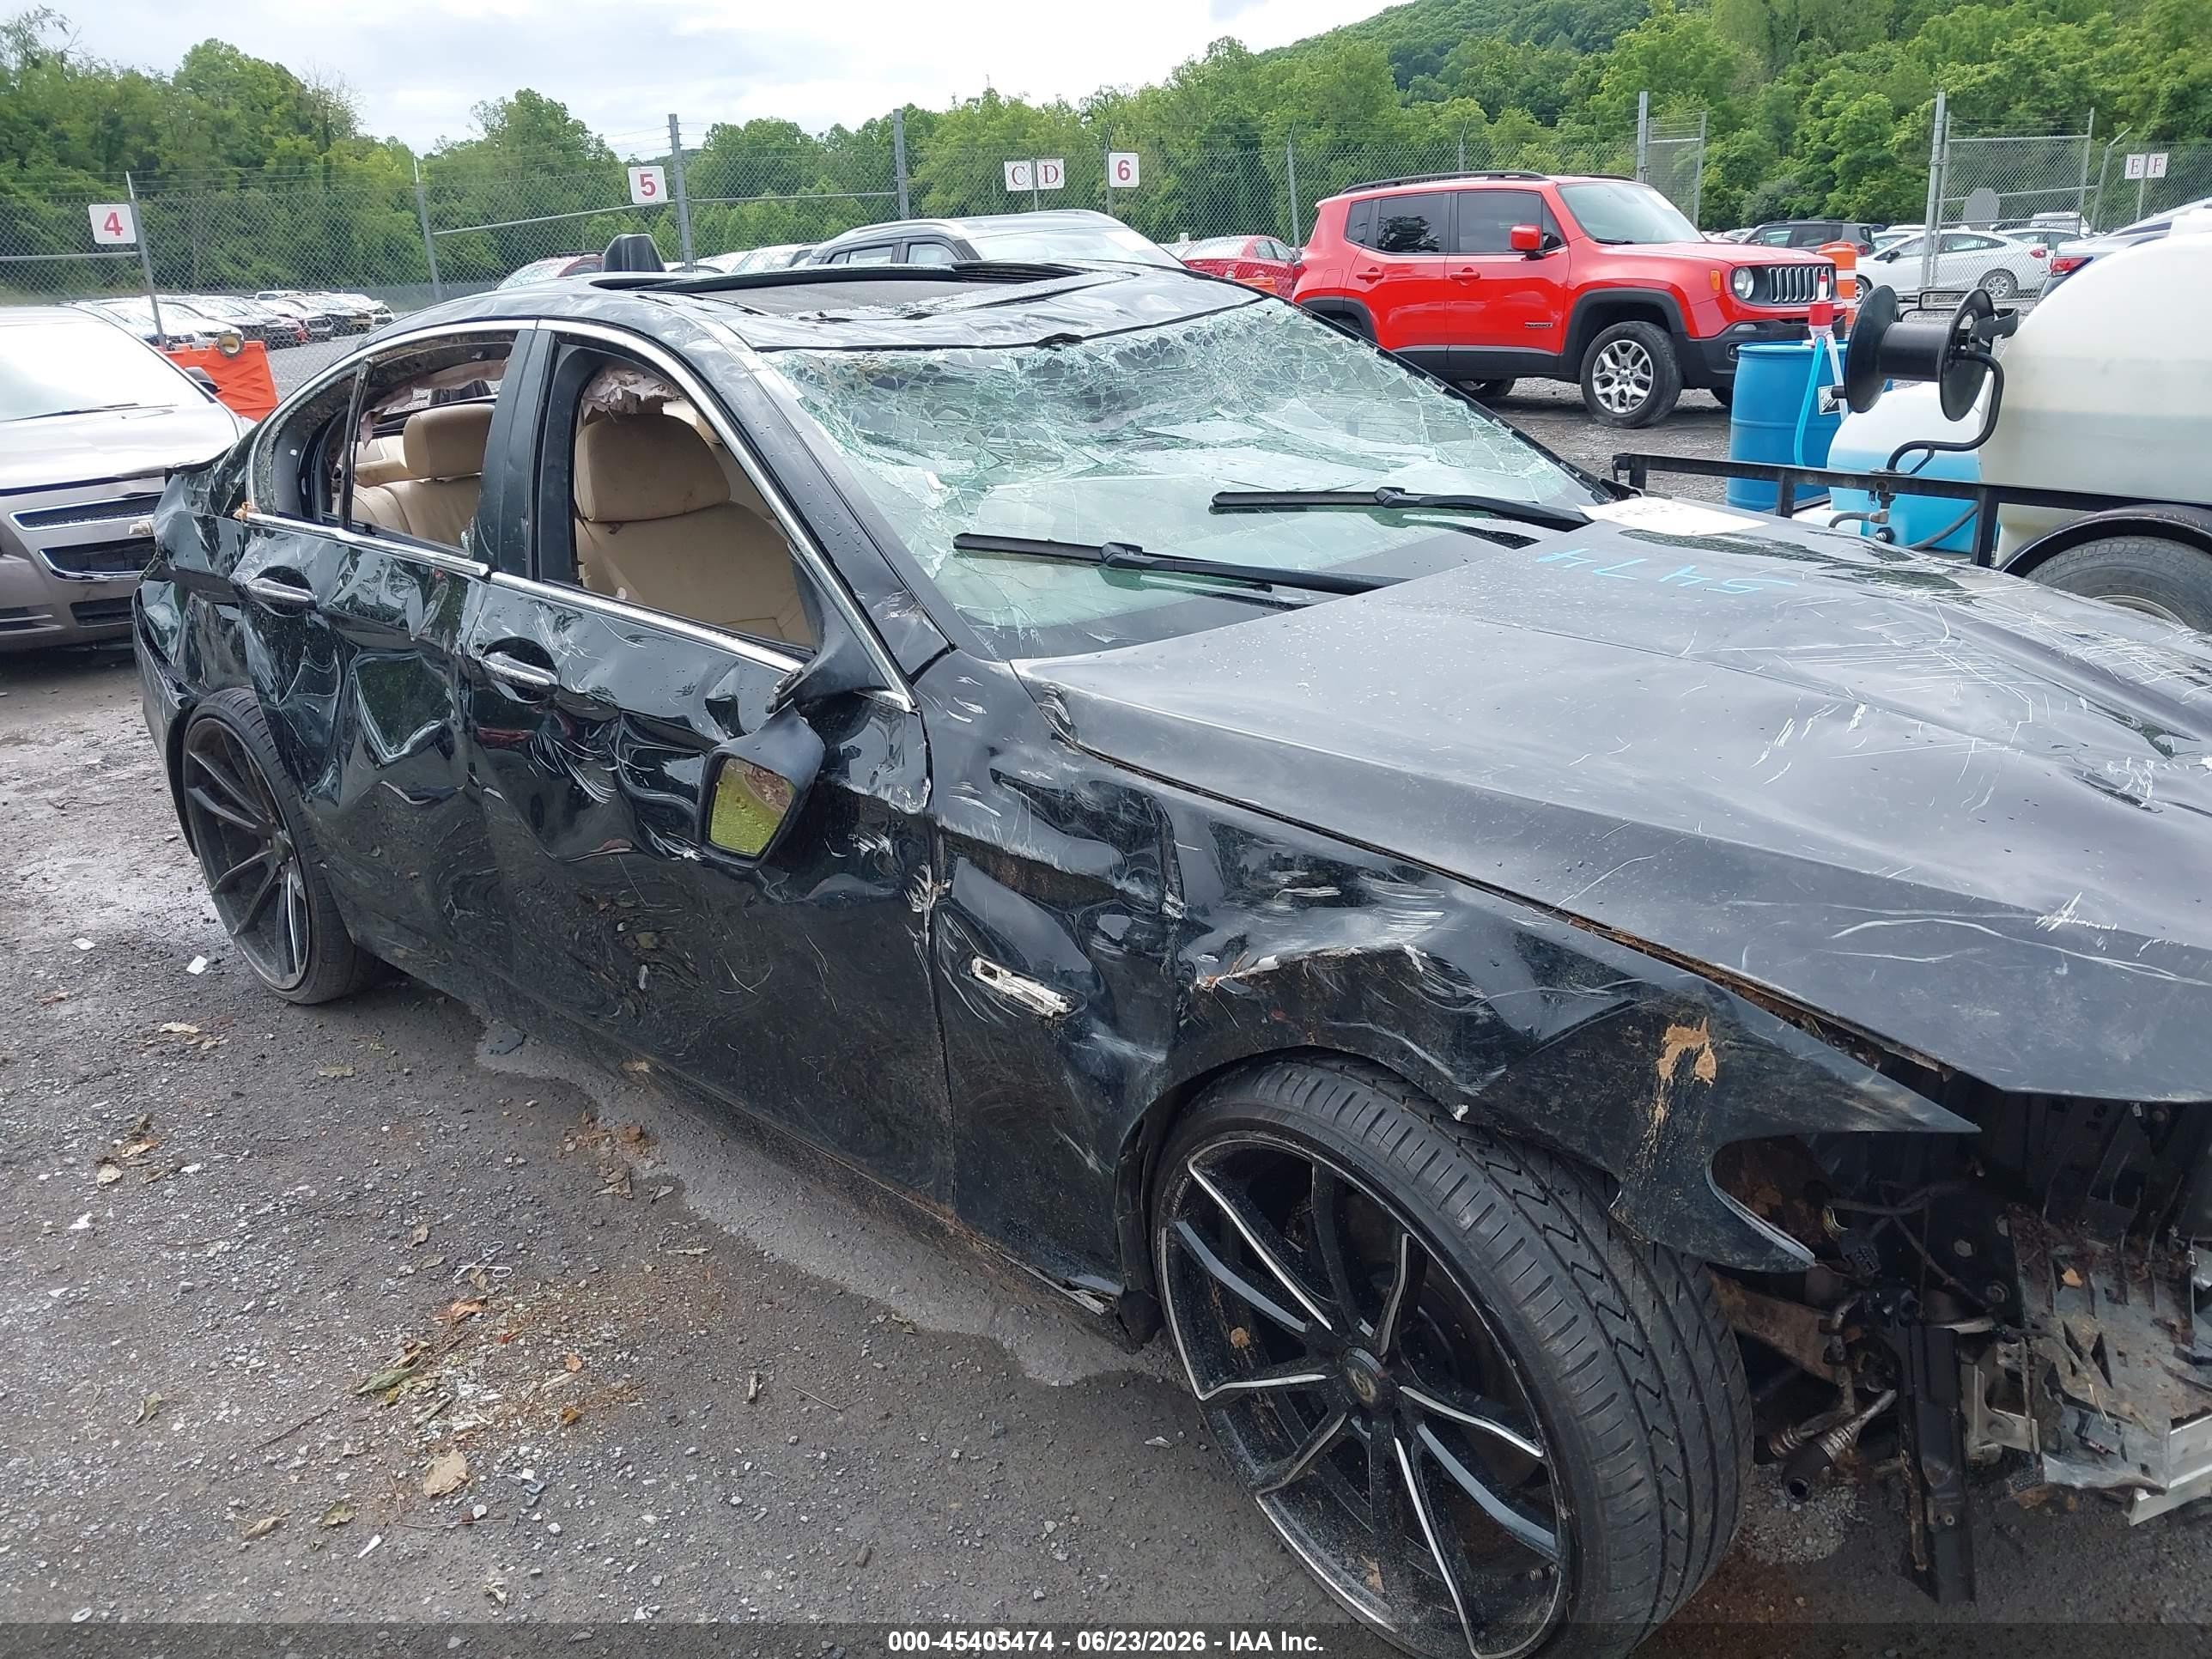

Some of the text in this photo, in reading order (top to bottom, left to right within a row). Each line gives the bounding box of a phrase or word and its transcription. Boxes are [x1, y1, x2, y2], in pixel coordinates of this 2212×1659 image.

[1042, 164, 1059, 184] D
[1117, 159, 1131, 181] 6
[2130, 158, 2141, 174] E
[2152, 157, 2163, 173] F
[639, 173, 656, 197] 5
[1011, 166, 1026, 186] C
[104, 211, 124, 236] 4
